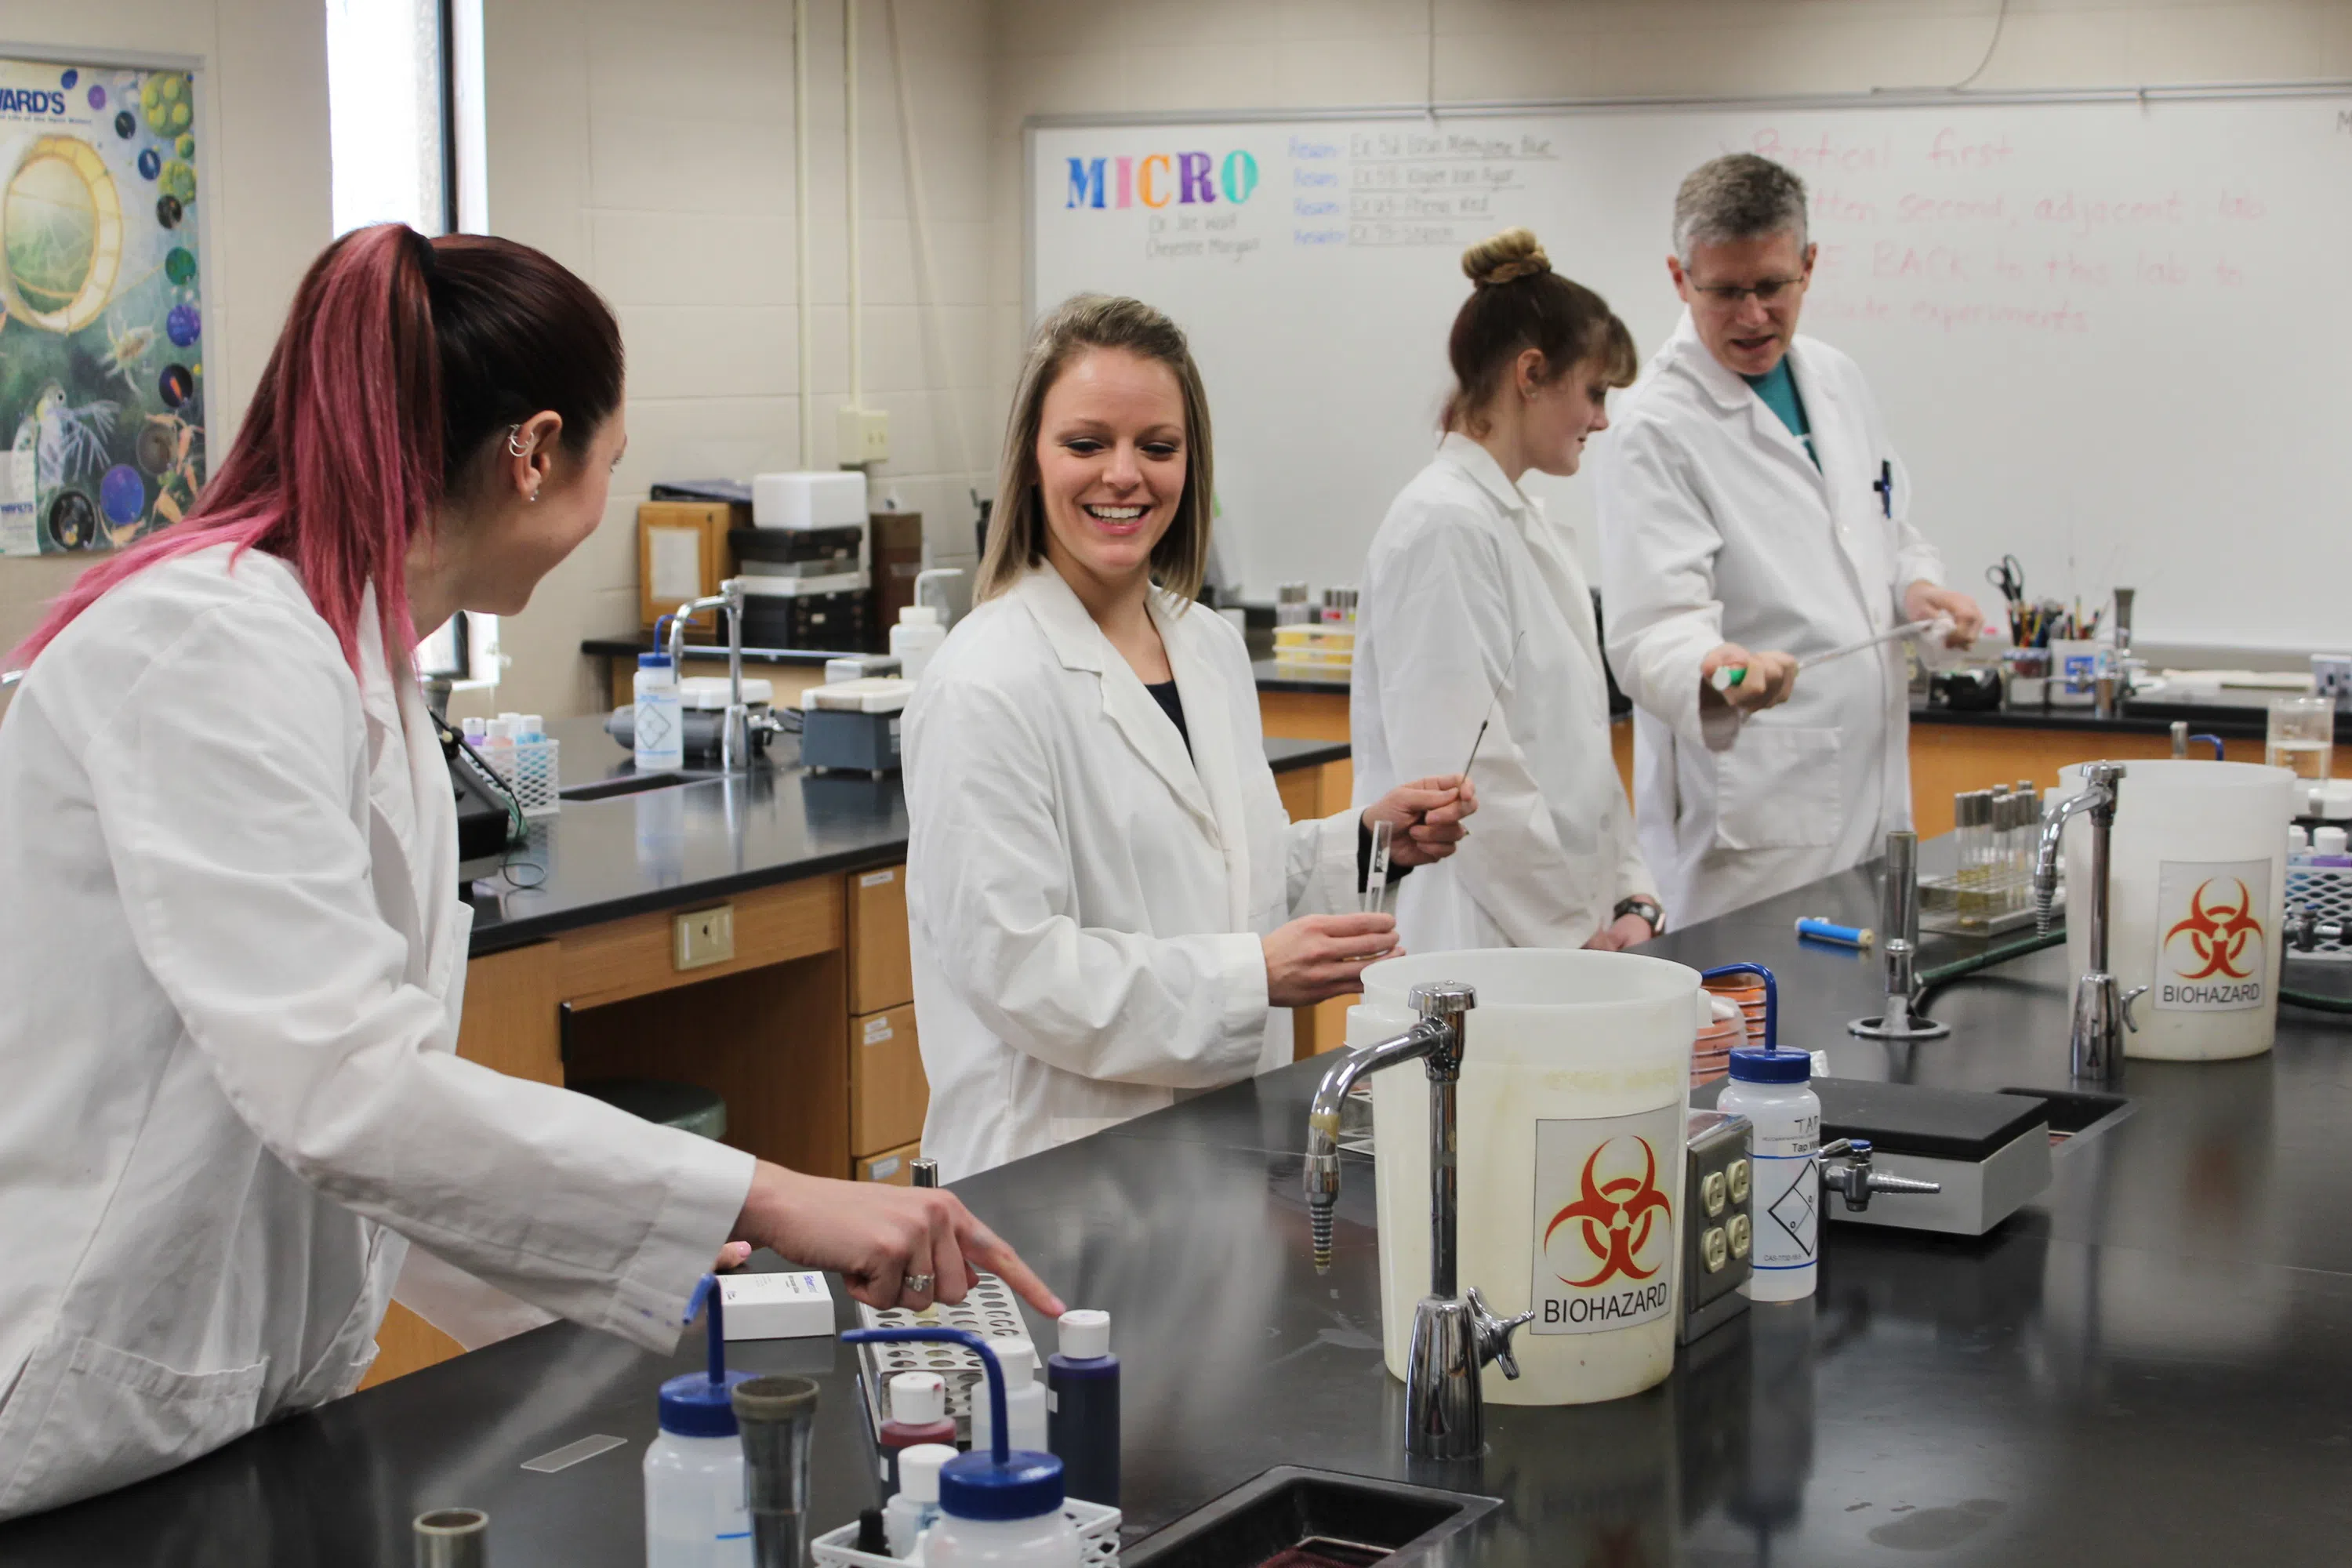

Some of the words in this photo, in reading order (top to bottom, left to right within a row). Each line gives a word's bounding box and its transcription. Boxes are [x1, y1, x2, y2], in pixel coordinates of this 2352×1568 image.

[0, 89, 65, 115] ARD'S
[1926, 127, 2014, 169] first
[1066, 150, 1258, 209] MICRO
[2136, 249, 2188, 287] lab
[2163, 983, 2259, 1004] BIOHAZARD
[1791, 1142, 1808, 1153] Tap
[1544, 1282, 1667, 1323] BIOHAZARD
